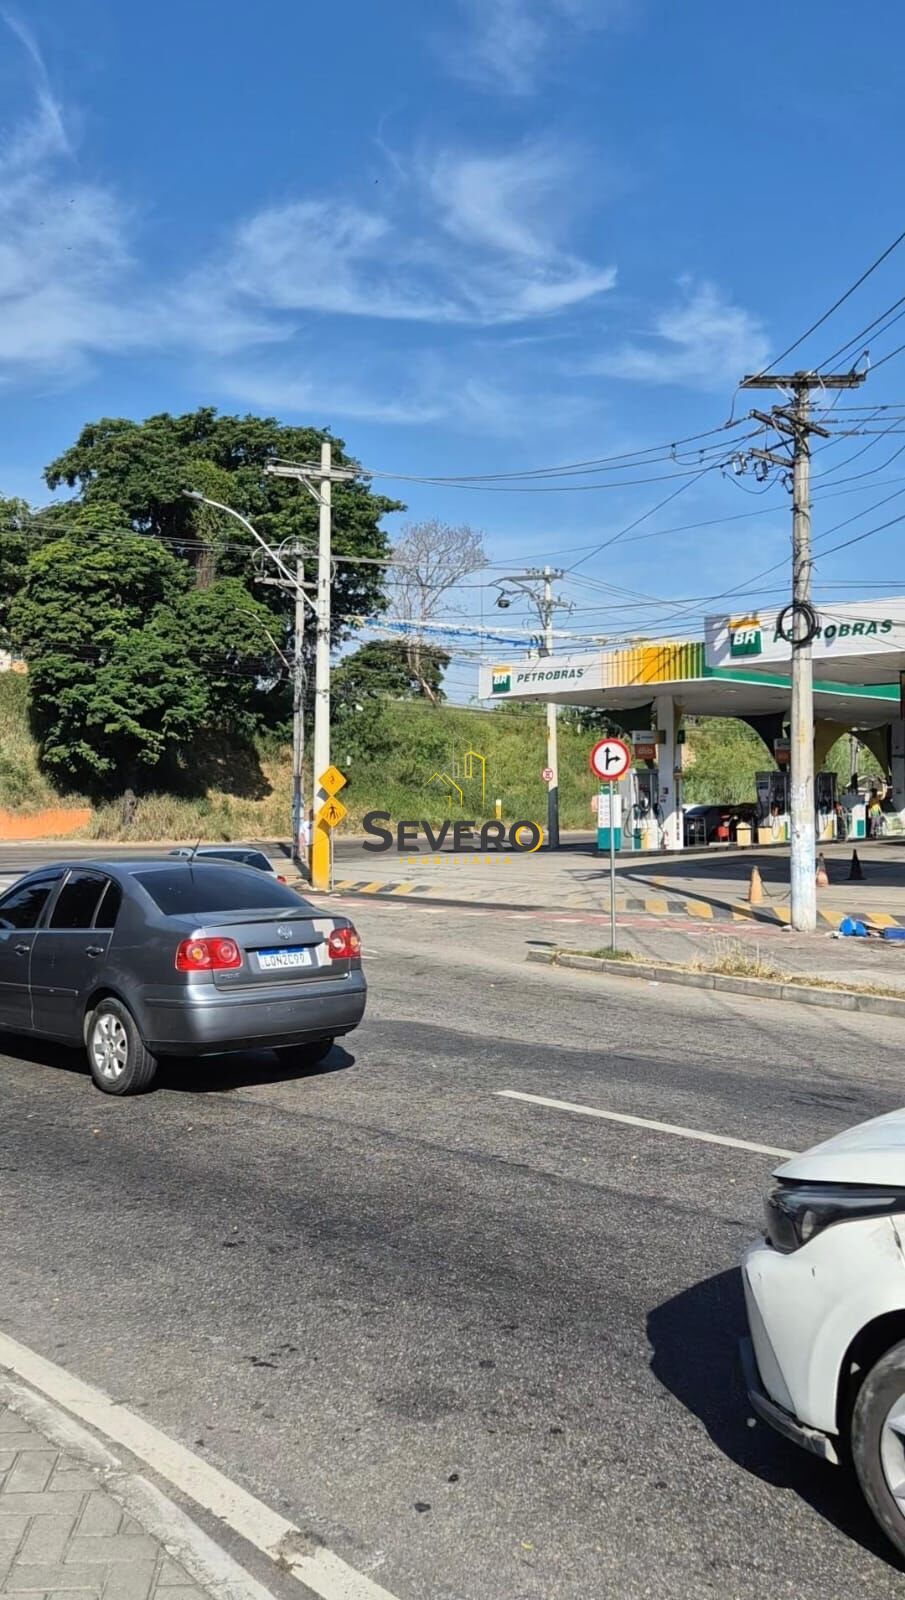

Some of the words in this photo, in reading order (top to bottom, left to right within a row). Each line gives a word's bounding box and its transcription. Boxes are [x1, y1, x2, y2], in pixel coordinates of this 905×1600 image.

[733, 630, 756, 646] BR
[773, 619, 893, 643] PEROBRAS
[516, 668, 585, 684] PETROBRAS
